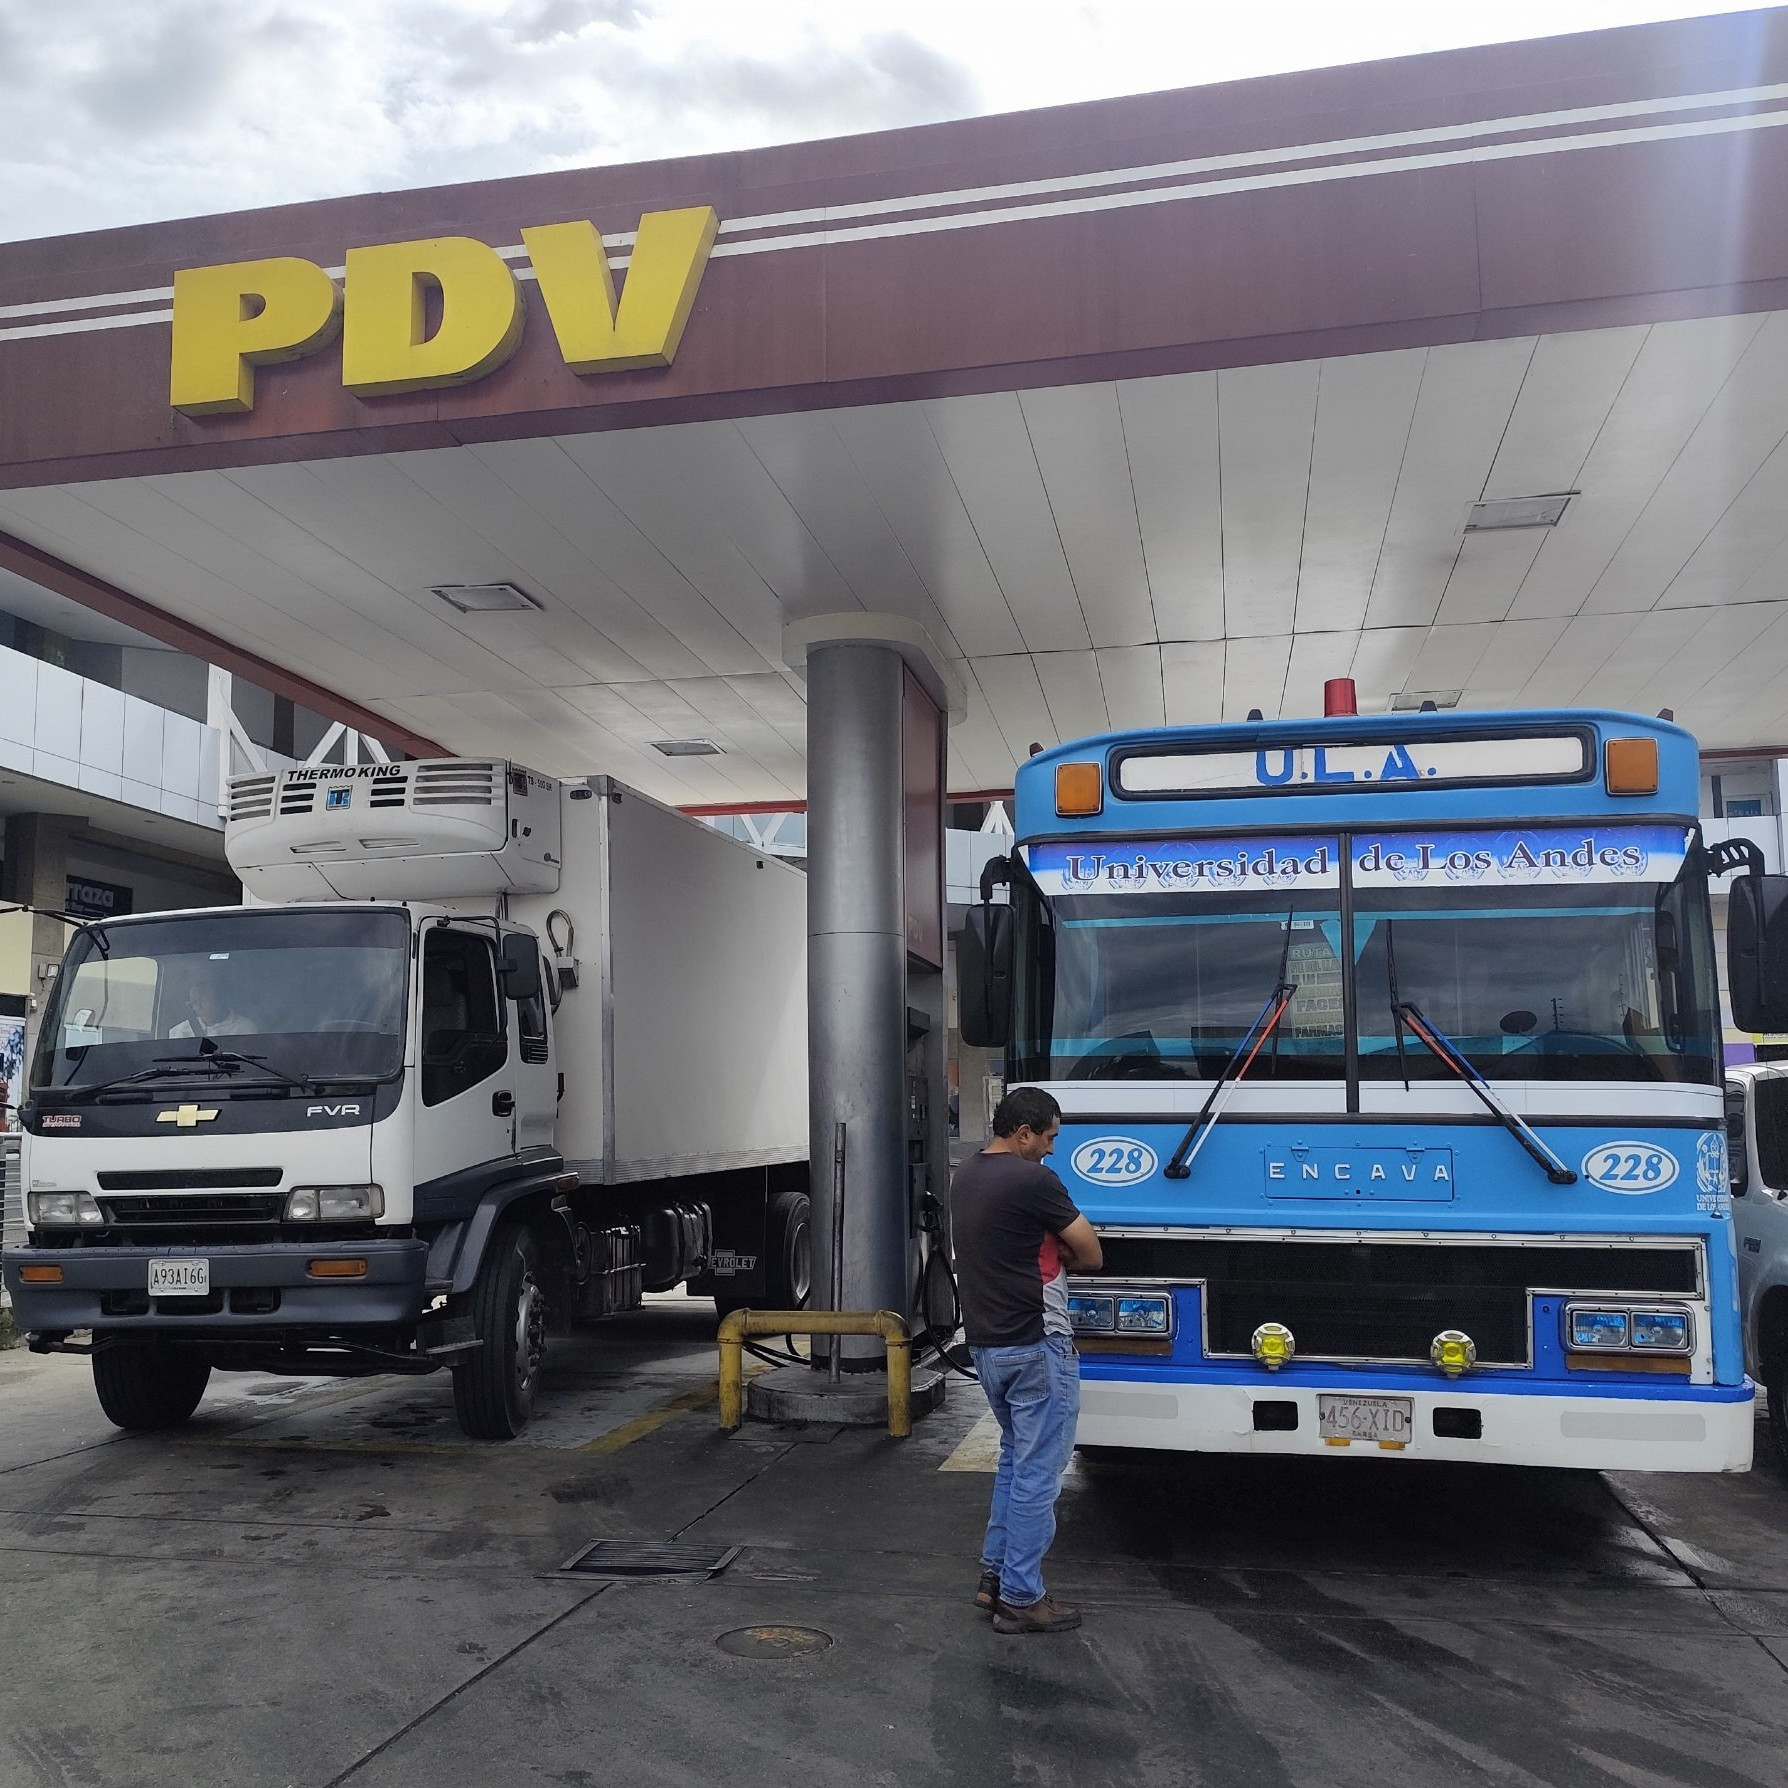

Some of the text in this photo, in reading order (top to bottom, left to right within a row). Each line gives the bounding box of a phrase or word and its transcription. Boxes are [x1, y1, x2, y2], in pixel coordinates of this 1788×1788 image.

[170, 205, 720, 417] PDV
[287, 765, 401, 782] THERMO KING
[1256, 745, 1437, 787] U.L.A.
[1066, 838, 1640, 881] Universidad de Los Andes
[1292, 948, 1333, 958] RUTA
[43, 1115, 81, 1124] TURBO
[306, 1104, 361, 1117] FVR
[1086, 1147, 1143, 1174] 228
[1599, 1153, 1663, 1182] 228
[1269, 1162, 1450, 1181] ENCAVA
[711, 1256, 756, 1269] EVROLET
[1342, 1399, 1388, 1408] VENEZUELA
